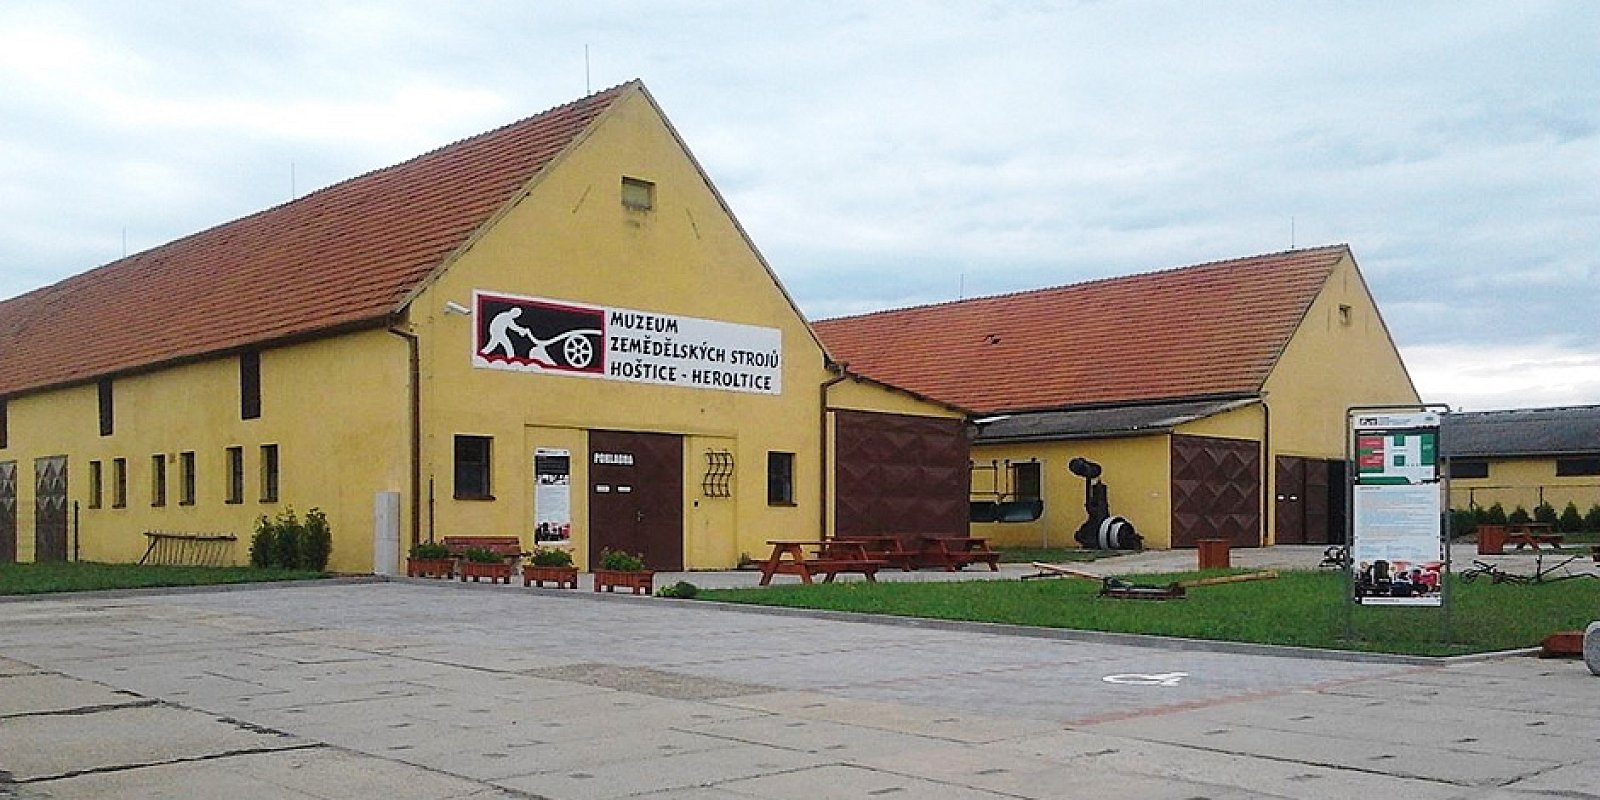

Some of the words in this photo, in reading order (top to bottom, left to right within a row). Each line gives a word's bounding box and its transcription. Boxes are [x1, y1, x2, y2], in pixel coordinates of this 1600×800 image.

[610, 311, 679, 334] MUZEUM
[610, 335, 726, 363] ZEMĚDĚLSKÝCH
[731, 349, 779, 369] STROJŮ
[610, 359, 677, 382] HOŠTICE
[692, 368, 772, 391] HEROLTICE
